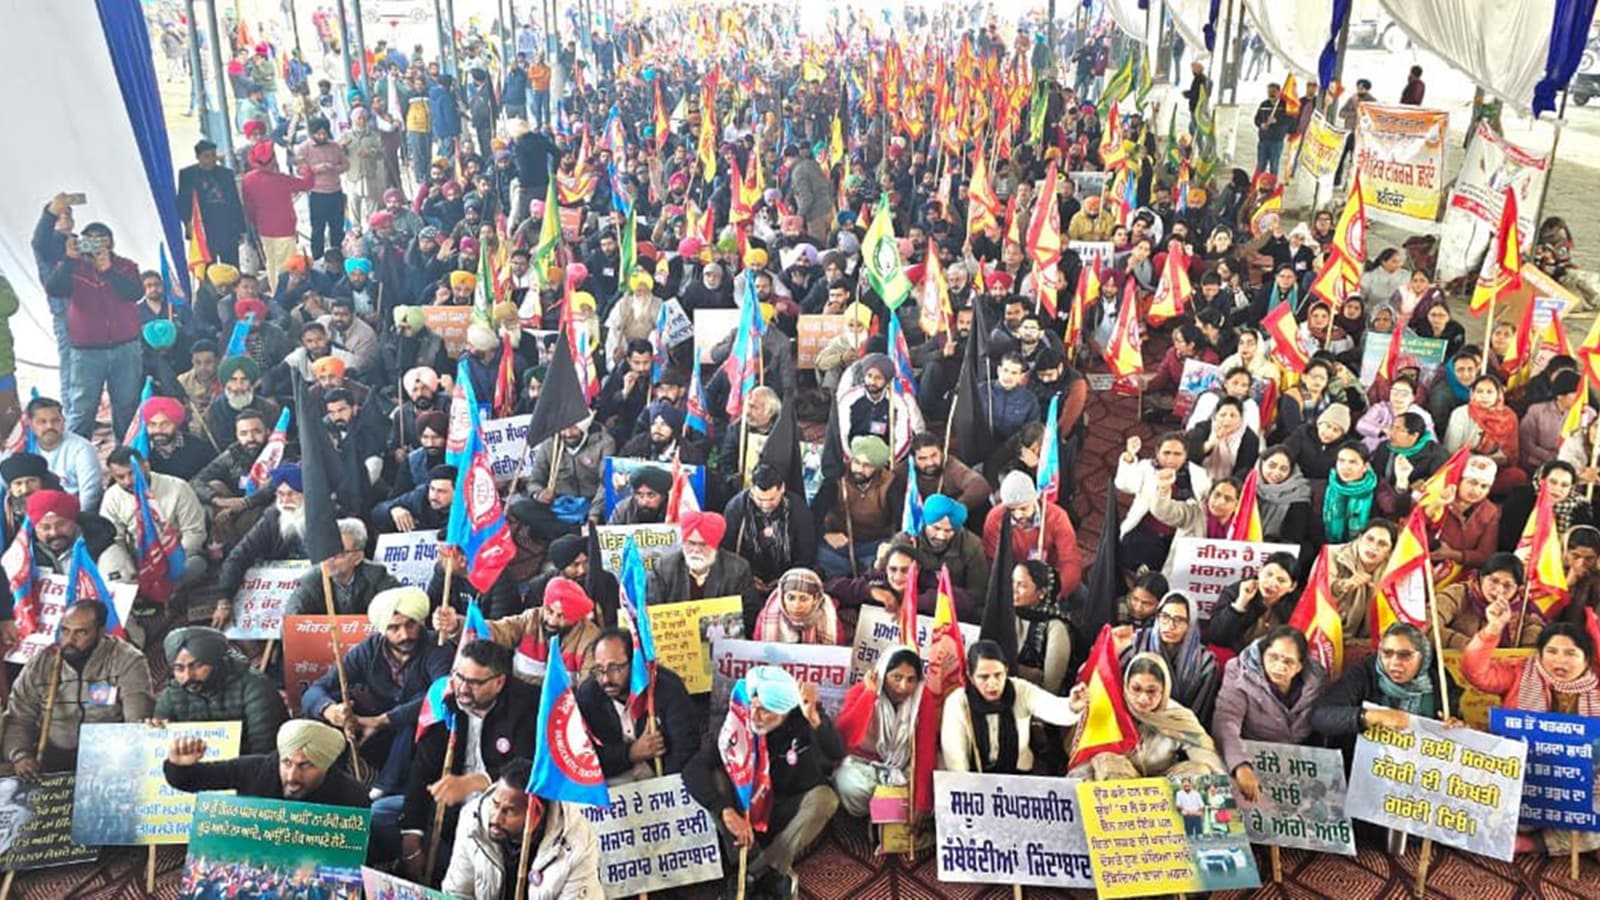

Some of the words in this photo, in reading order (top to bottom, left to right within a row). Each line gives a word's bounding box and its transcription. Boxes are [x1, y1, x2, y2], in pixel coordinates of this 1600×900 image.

[506, 423, 529, 441] ਸੰਘਰ
[384, 544, 410, 572] ਸਮੂਹ
[1197, 544, 1237, 561] ਜੀਨਾ
[1243, 546, 1255, 562] ਹੈ
[1190, 564, 1235, 578] ਮਰਨਾ
[874, 622, 903, 642] ਮੁਆ
[718, 652, 769, 680] ਪੰਜਾ
[1288, 758, 1318, 778] ਮਾਰ
[1421, 737, 1455, 761] ਲਈ
[1461, 750, 1521, 779] ਸਰਕਾਰੀ
[1372, 755, 1415, 786] ਨੌਕਰੀ
[1421, 768, 1441, 791] ਦੀ
[1447, 775, 1500, 808] ਲਿਖਤੀ
[580, 794, 627, 823] ਆਵਜੇ
[632, 791, 643, 815] ਦੇ
[647, 790, 675, 812] ਨਾਮ
[950, 790, 985, 829] ਸਮੂਹ
[640, 821, 671, 844] ਕਰਨ
[676, 809, 709, 837] ਵਾਲੀ
[1315, 820, 1351, 844] ਆਓ
[607, 856, 652, 884] ਸਰਕਾਰ
[658, 844, 717, 878] ਮੁਰਦਾਬਾਦ
[941, 836, 1019, 875] ਜੱਥੇਬੰਦੀਆਂ
